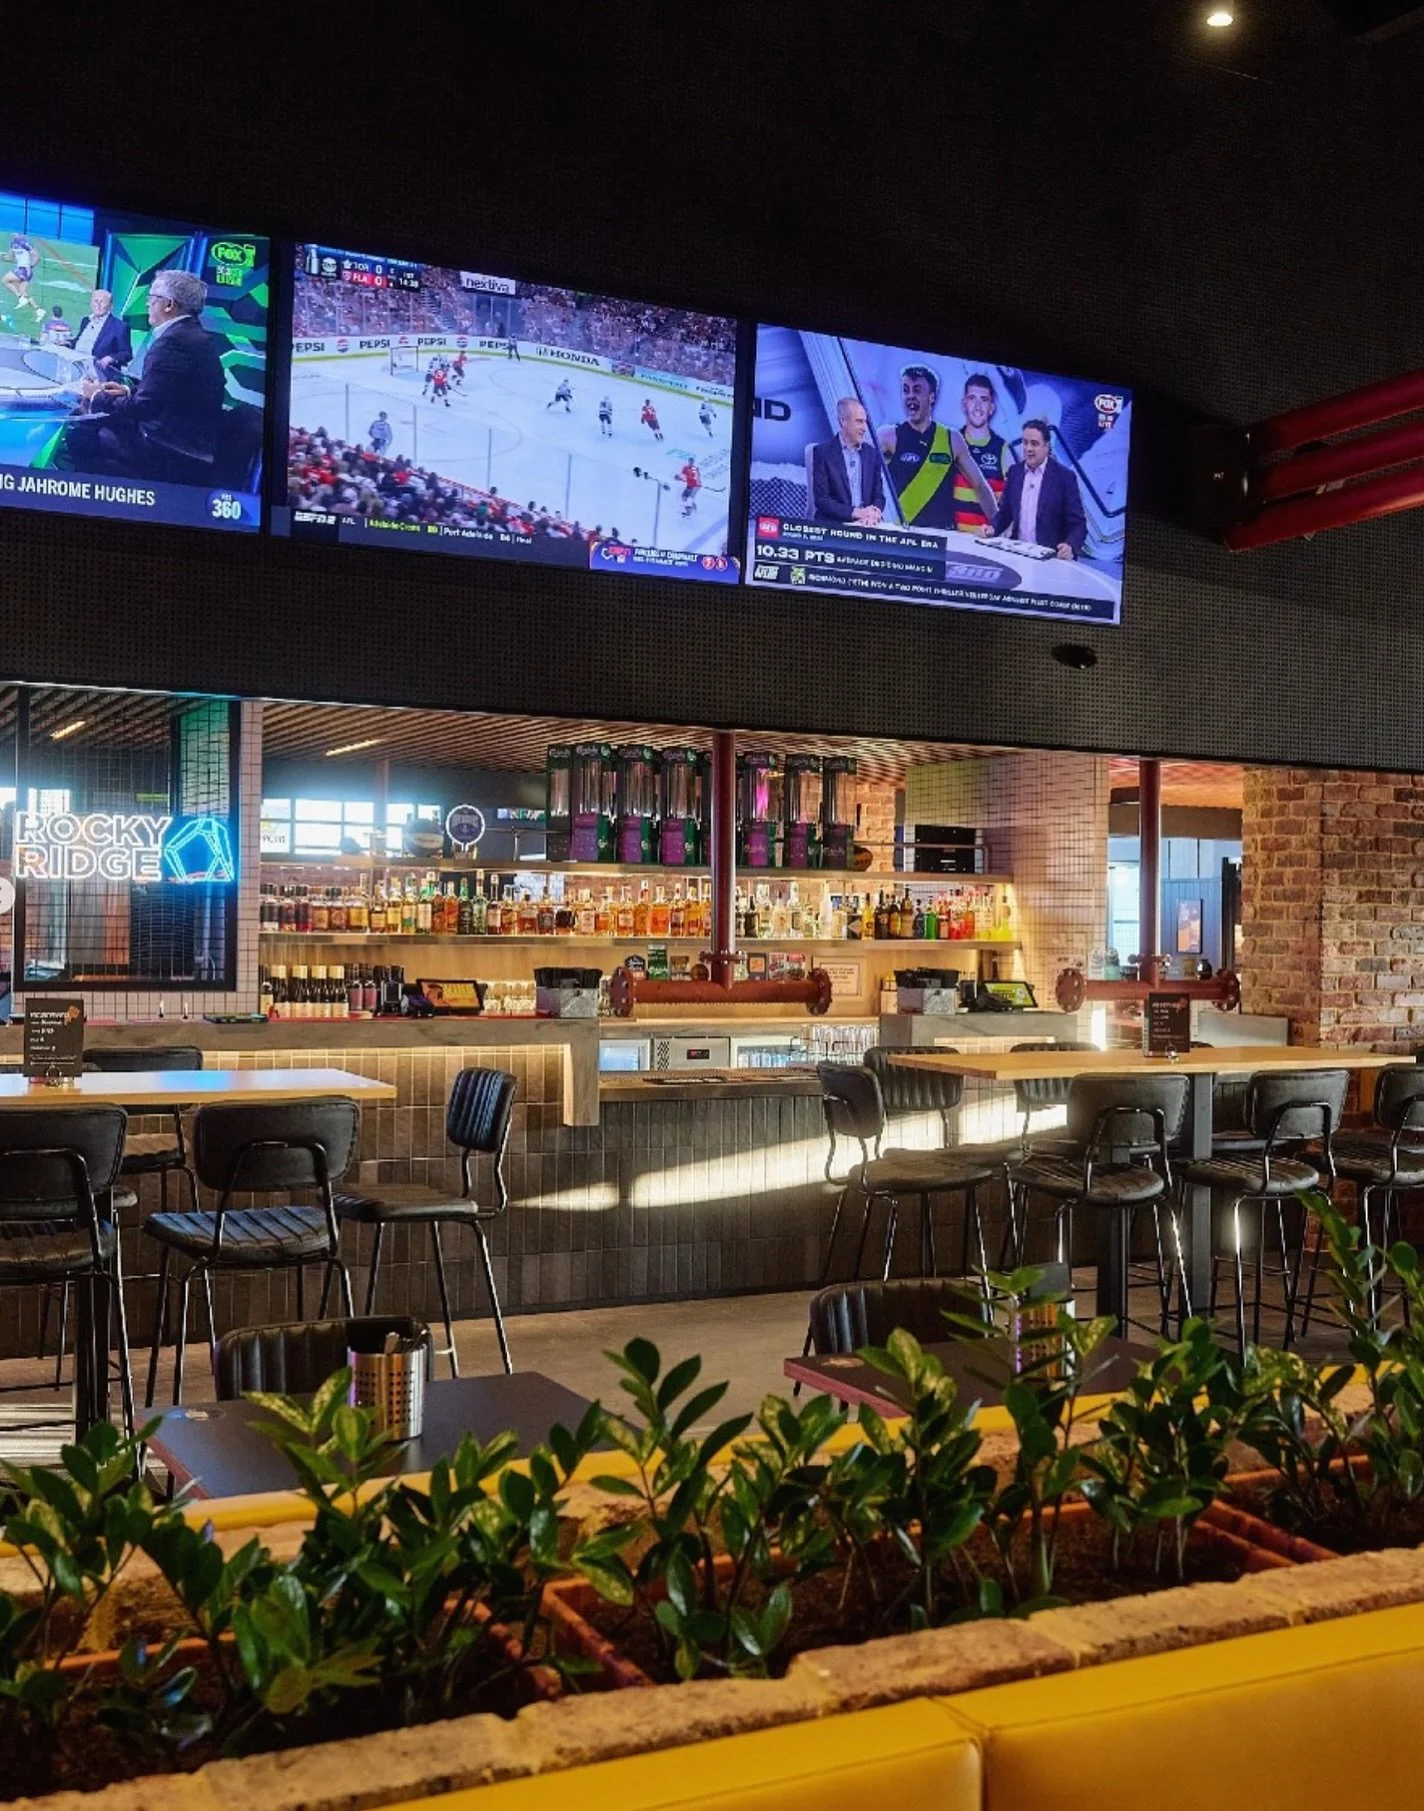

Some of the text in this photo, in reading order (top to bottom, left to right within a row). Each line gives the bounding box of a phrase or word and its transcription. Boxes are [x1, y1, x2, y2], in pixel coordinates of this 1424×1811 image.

[217, 246, 242, 261] FOX
[375, 264, 383, 274] 0
[353, 273, 382, 286] FLA 0
[466, 278, 510, 294] nextiva
[293, 337, 509, 352] EPSI PEPSI PEPSI PEPS
[550, 348, 600, 366] HONDA
[17, 476, 91, 499] JAHROME
[94, 484, 155, 506] HUGHES
[212, 499, 242, 520] 360
[443, 526, 460, 536] Port
[783, 523, 828, 535] CLOSEST
[830, 529, 863, 540] ROUND
[866, 533, 877, 541] IN
[879, 535, 898, 544] THE
[900, 538, 917, 546] AFL
[921, 540, 938, 549] ERA
[757, 544, 799, 561] 10.33
[804, 549, 835, 564] PTS
[16, 811, 173, 849] ROCKY
[15, 844, 162, 881] RIDGE
